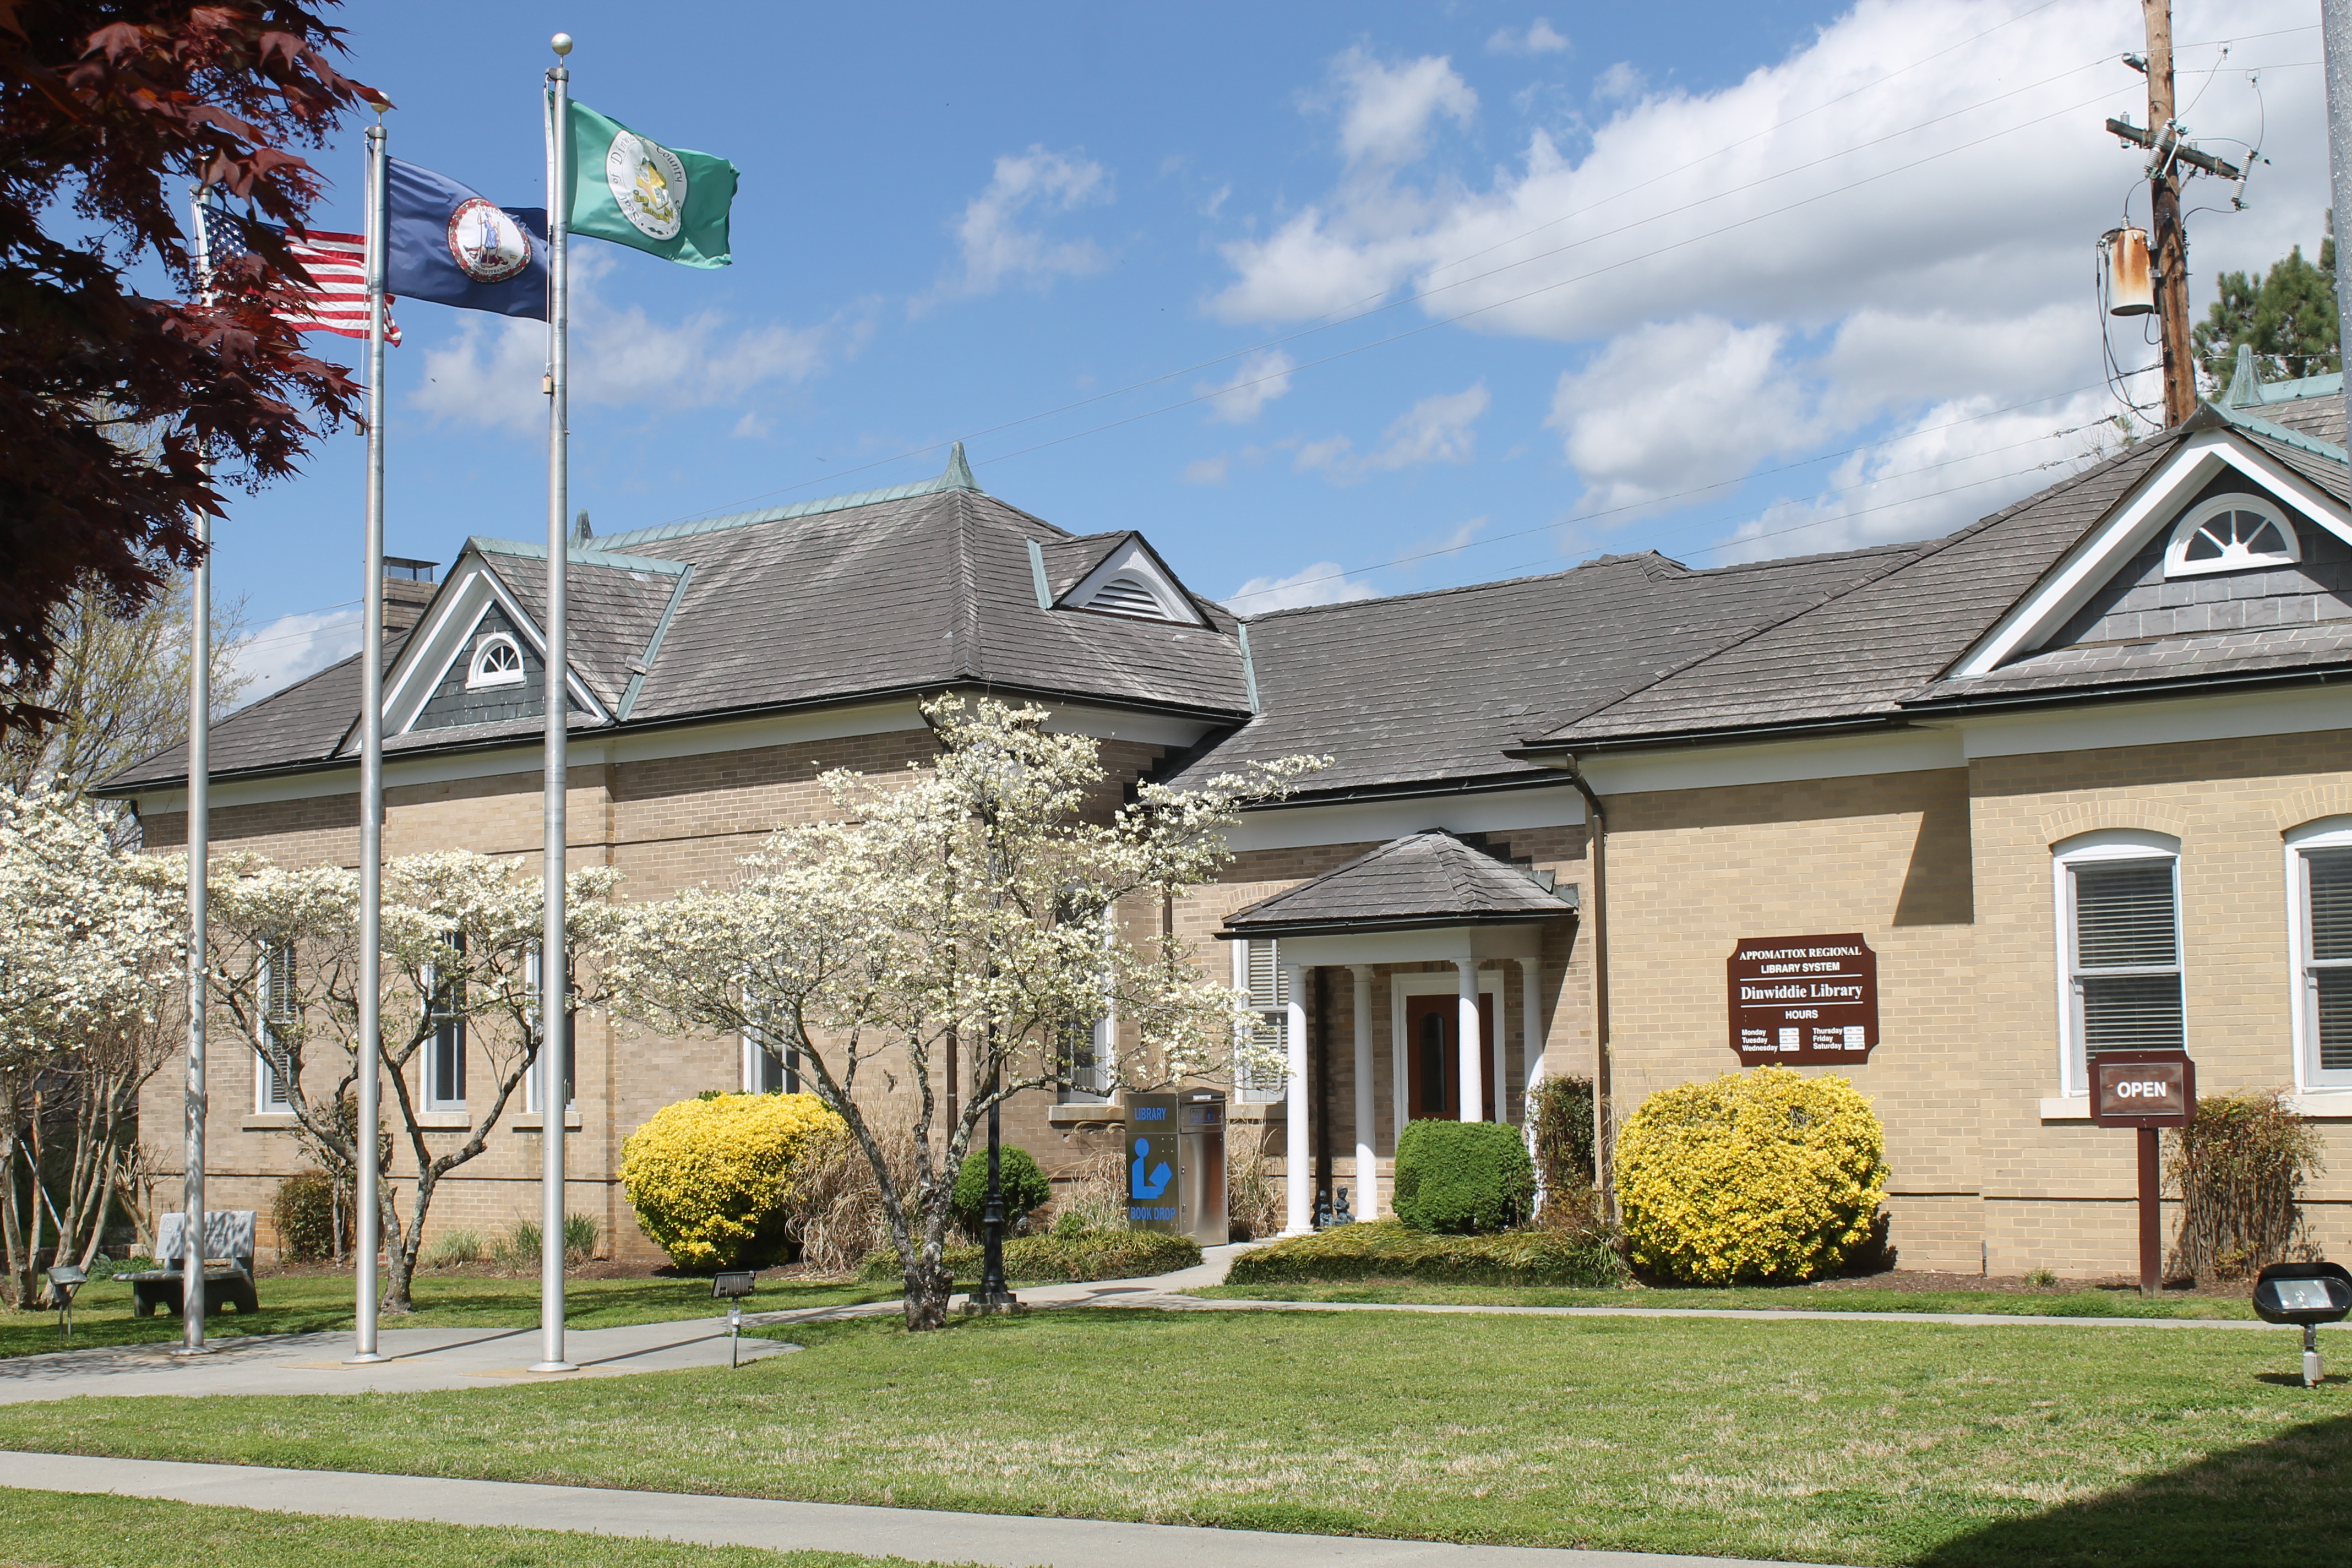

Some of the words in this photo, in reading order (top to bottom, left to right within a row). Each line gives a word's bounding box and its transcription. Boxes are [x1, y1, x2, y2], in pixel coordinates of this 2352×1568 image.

[656, 146, 683, 182] County
[609, 170, 622, 184] of
[474, 206, 505, 220] VIRGINIA
[617, 195, 639, 222] Seal
[1739, 949, 1807, 961] APPOMATTOX
[1809, 946, 1862, 957] REGIONAL
[1761, 963, 1800, 974] LIBRARY
[1802, 962, 1840, 972] SYSTEM
[1740, 984, 1807, 1000] Dinwiddie
[1810, 983, 1863, 999] Library
[1785, 1010, 1819, 1020] HOURS
[1741, 1028, 1766, 1037] Monday
[1741, 1044, 1778, 1053] Wednesday
[2116, 1081, 2166, 1098] OPEN
[1134, 1107, 1167, 1121] LIBRARY
[1130, 1207, 1152, 1220] BOOK
[1154, 1207, 1176, 1221] DROP
